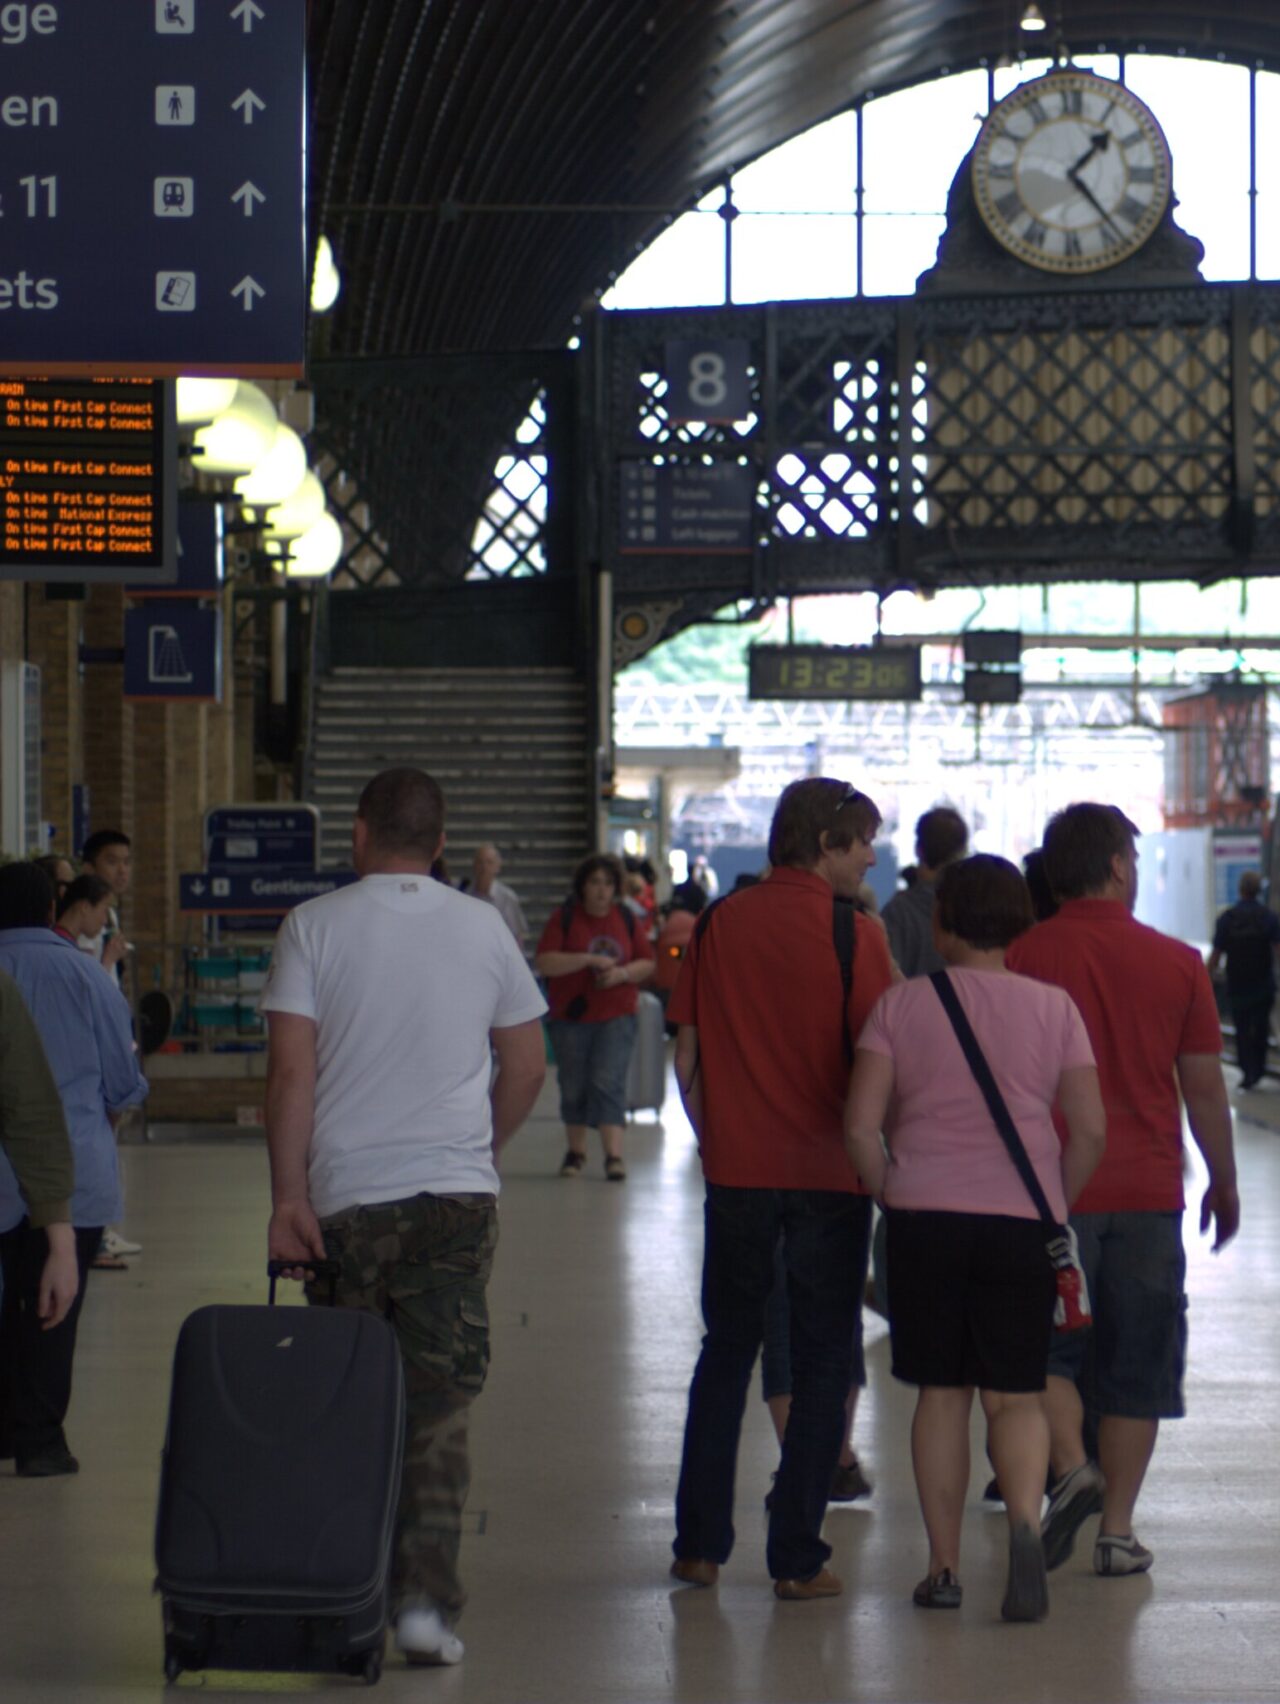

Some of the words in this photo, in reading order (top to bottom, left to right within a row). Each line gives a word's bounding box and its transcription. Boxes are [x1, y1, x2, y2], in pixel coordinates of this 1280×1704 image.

[1, 3, 58, 43] ge
[2, 93, 58, 126] en
[19, 175, 57, 217] 11
[688, 352, 726, 407] 8
[7, 399, 20, 411] On
[54, 399, 82, 413] First
[86, 400, 105, 414] Cap
[109, 401, 153, 415] Connect
[7, 414, 20, 426] On
[54, 414, 82, 429] First
[86, 415, 105, 430] Cap
[109, 416, 153, 430] Connect
[7, 460, 20, 473] On
[54, 461, 82, 475] First
[86, 462, 105, 476] Cap
[109, 463, 153, 476] Connect
[6, 491, 20, 503] On
[54, 491, 82, 505] First
[86, 492, 105, 506] Cap
[109, 493, 153, 506] Connect
[6, 507, 20, 519] On
[59, 507, 104, 520] National
[108, 508, 152, 522] Express
[6, 522, 19, 534] On
[53, 522, 82, 536] First
[86, 523, 105, 537] Cap
[109, 524, 152, 537] Connect
[6, 537, 19, 549] On
[53, 538, 82, 551] First
[86, 539, 105, 552] Cap
[109, 539, 152, 552] Connect
[780, 657, 872, 689] 13:23
[251, 877, 336, 896] Gentlemen
